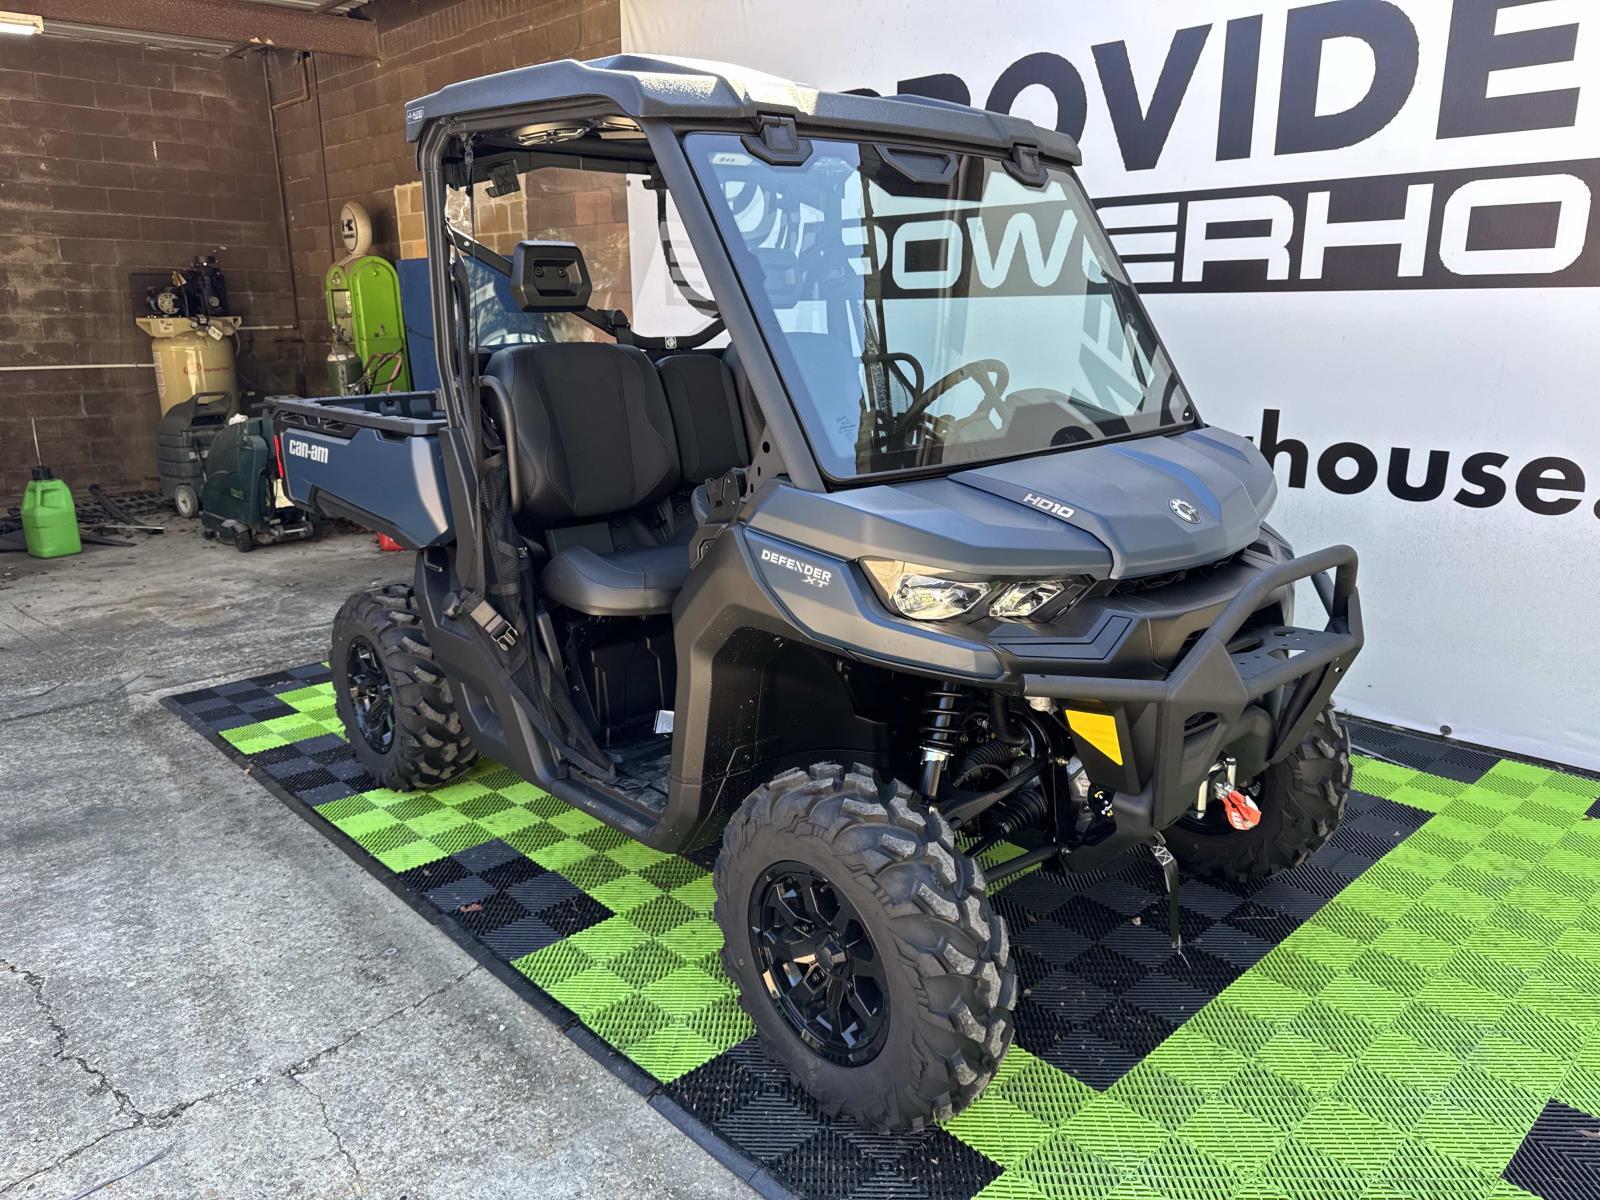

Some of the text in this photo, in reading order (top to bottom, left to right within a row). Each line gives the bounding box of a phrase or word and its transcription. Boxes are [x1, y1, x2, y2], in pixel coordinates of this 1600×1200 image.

[842, 0, 1581, 171] OVIDE
[289, 439, 329, 464] can-am
[1245, 408, 1600, 520] house
[1023, 493, 1075, 518] HD10
[761, 549, 832, 582] DEFENDER
[801, 576, 829, 588] XT
